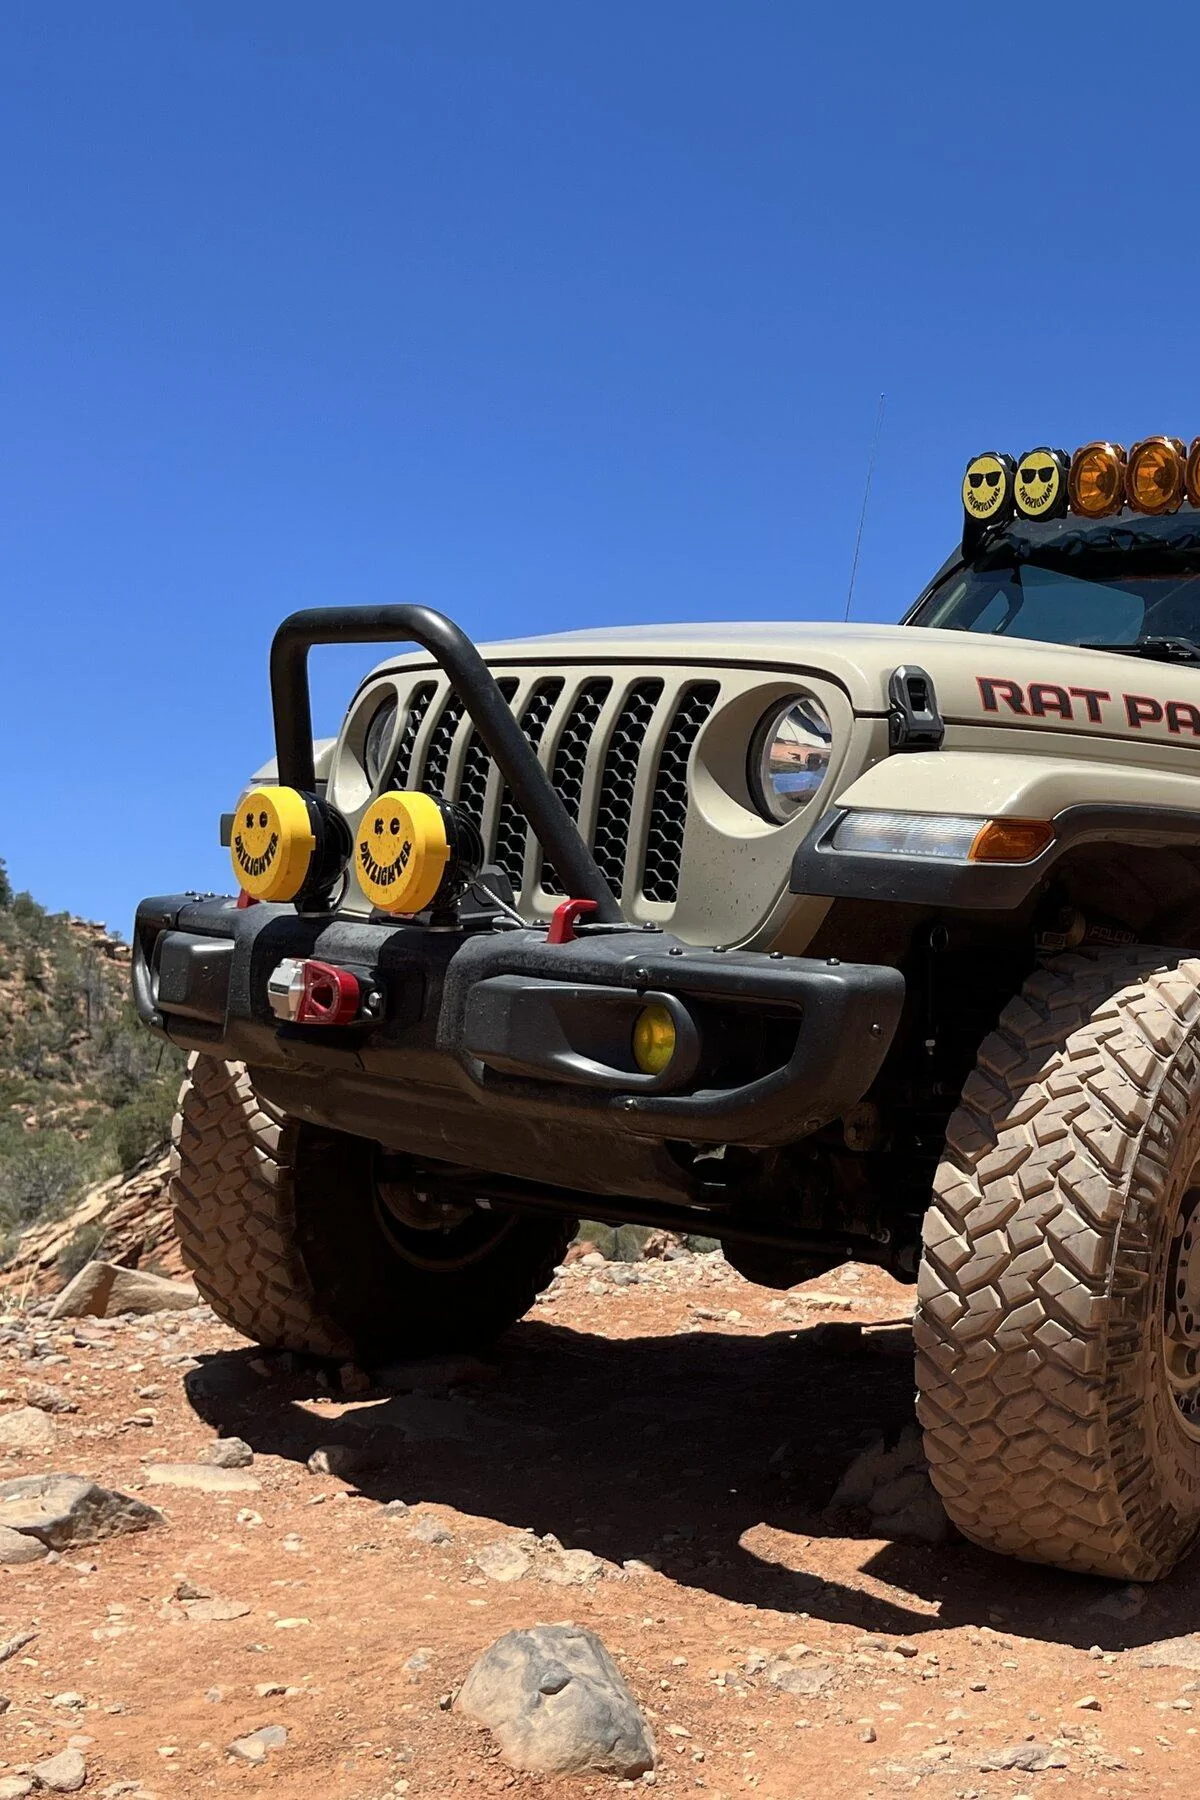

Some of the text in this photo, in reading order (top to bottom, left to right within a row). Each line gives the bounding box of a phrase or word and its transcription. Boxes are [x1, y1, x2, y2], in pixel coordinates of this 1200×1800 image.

[975, 676, 1111, 725] RAT
[234, 832, 279, 877] DAYLIGHTER
[359, 840, 413, 886] DAYLIGHTER
